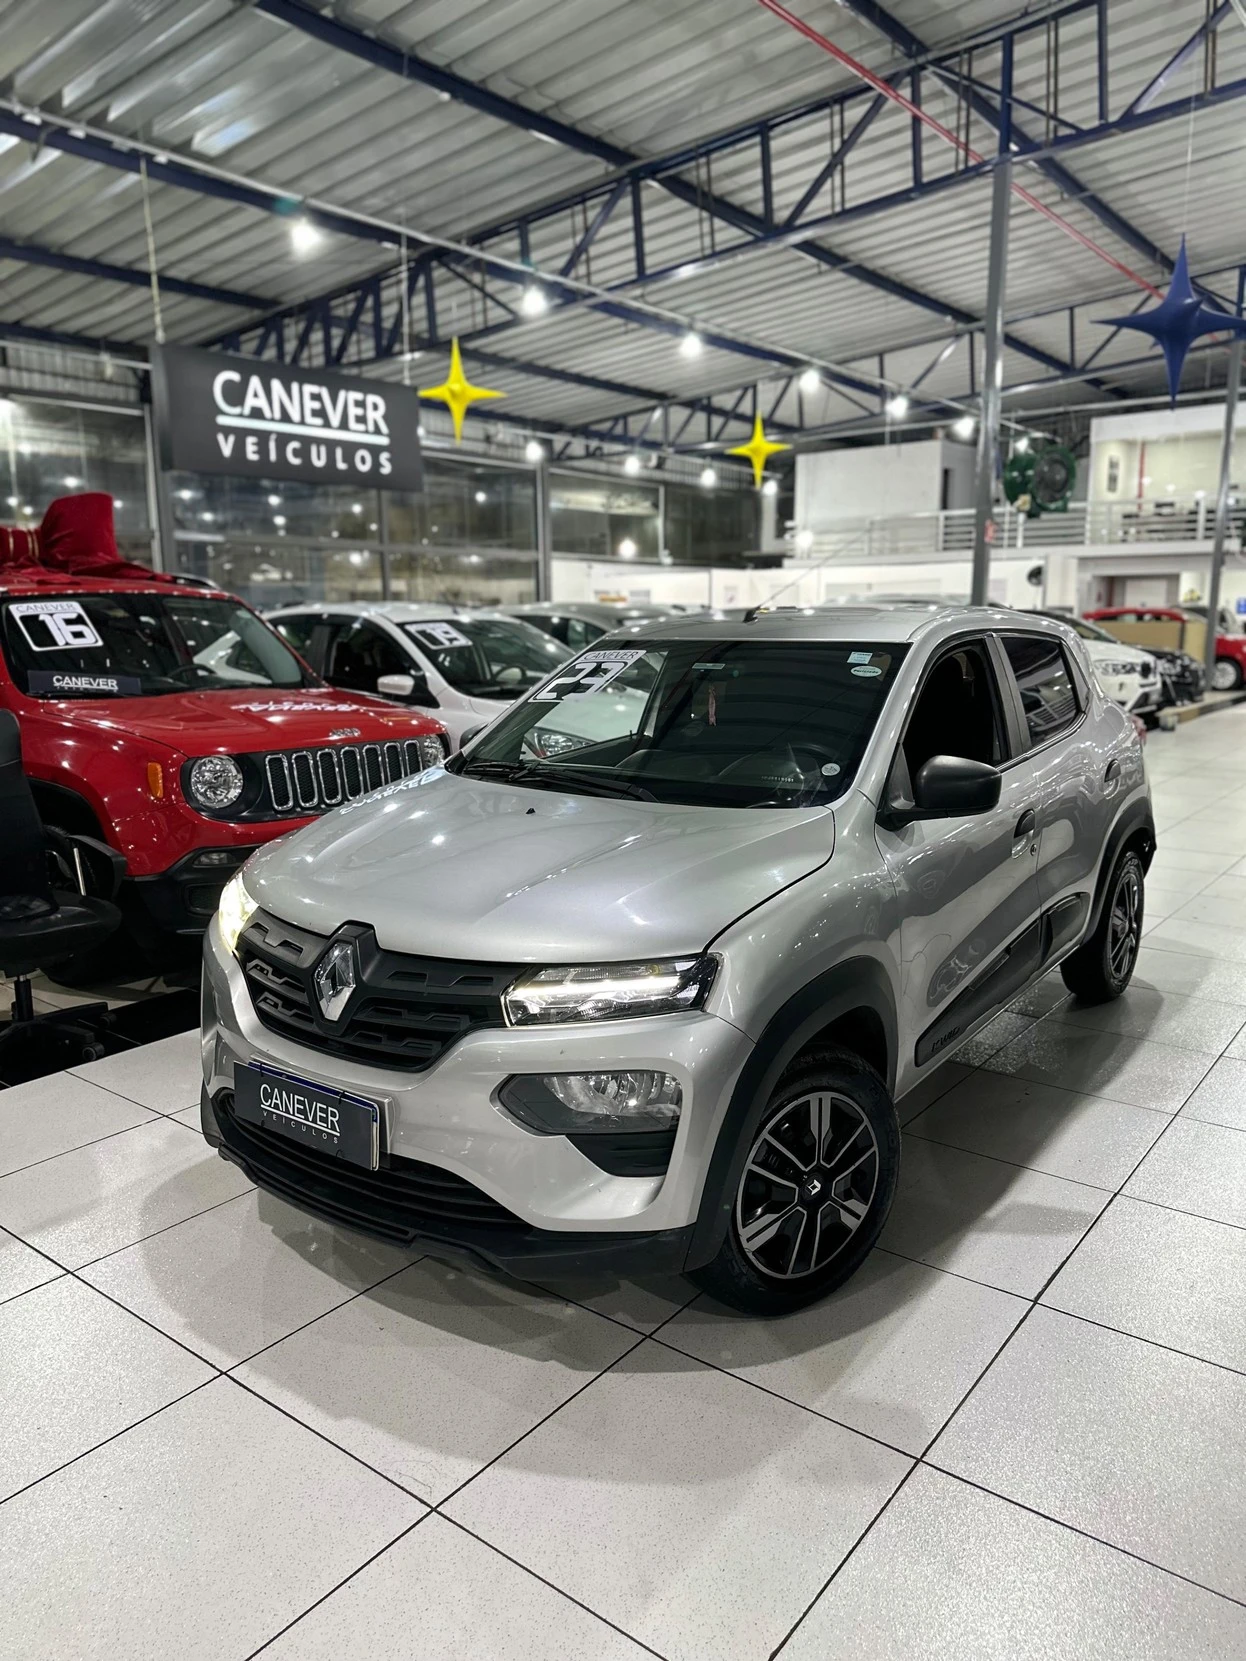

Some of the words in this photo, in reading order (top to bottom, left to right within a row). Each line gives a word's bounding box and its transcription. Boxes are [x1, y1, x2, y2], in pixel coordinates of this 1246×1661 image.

[213, 370, 389, 434] CANEVER
[216, 432, 393, 475] VEÍCULOS
[17, 603, 75, 614] CANEVER
[38, 613, 96, 647] 16
[584, 650, 639, 660] CANEVER
[53, 676, 117, 689] CANEVER
[536, 662, 624, 700] 23
[260, 1083, 340, 1132] CANEVER
